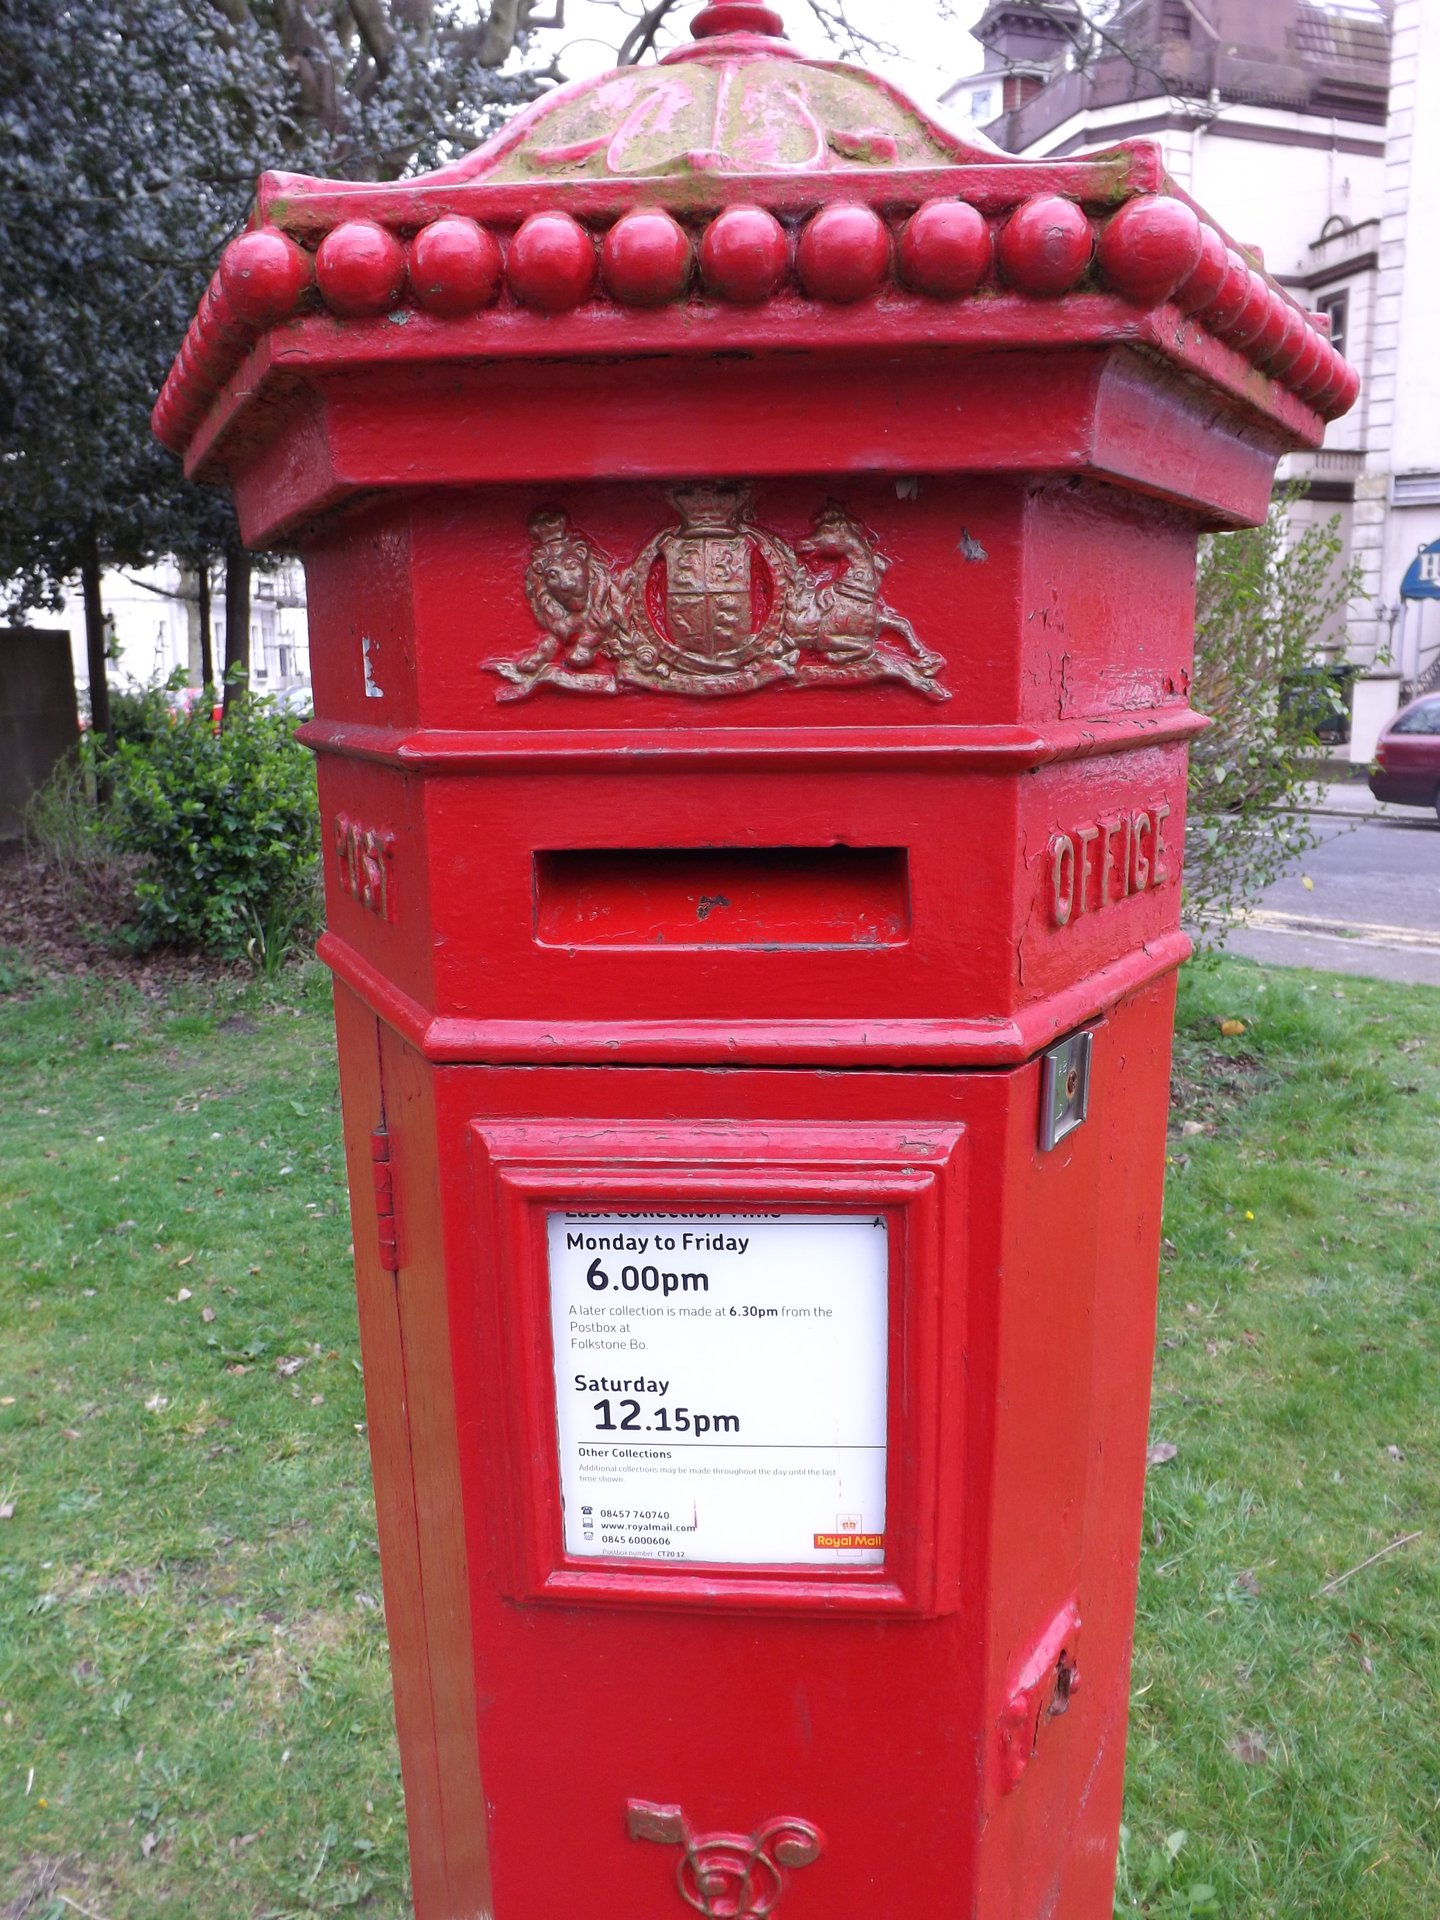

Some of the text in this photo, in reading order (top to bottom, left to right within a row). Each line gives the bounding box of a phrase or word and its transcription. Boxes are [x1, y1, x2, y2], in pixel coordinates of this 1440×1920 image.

[566, 1232, 749, 1255] Monday to Friday
[586, 1257, 709, 1297] 6.00pm
[568, 1304, 833, 1319] A later collection is made at 6.30pm from the
[570, 1321, 631, 1333] Postbox at
[571, 1338, 649, 1350] Folkstone Bo.
[574, 1374, 670, 1396] Saturday
[593, 1399, 740, 1437] 12.15pm
[578, 1447, 672, 1459] Other Collections
[579, 1464, 617, 1473] Additional
[619, 1466, 659, 1474] collections
[678, 1466, 688, 1475] be
[690, 1467, 711, 1475] made
[713, 1467, 757, 1476] throughout
[759, 1468, 772, 1476] the
[773, 1468, 787, 1477] day
[788, 1467, 806, 1476] until
[808, 1468, 821, 1476] the
[580, 1475, 624, 1483] time shown
[600, 1509, 670, 1519] 08457 740740
[600, 1522, 696, 1532] www.royalmail.com
[601, 1535, 671, 1545] 0845 6000606
[817, 1535, 882, 1547] Royal Mail
